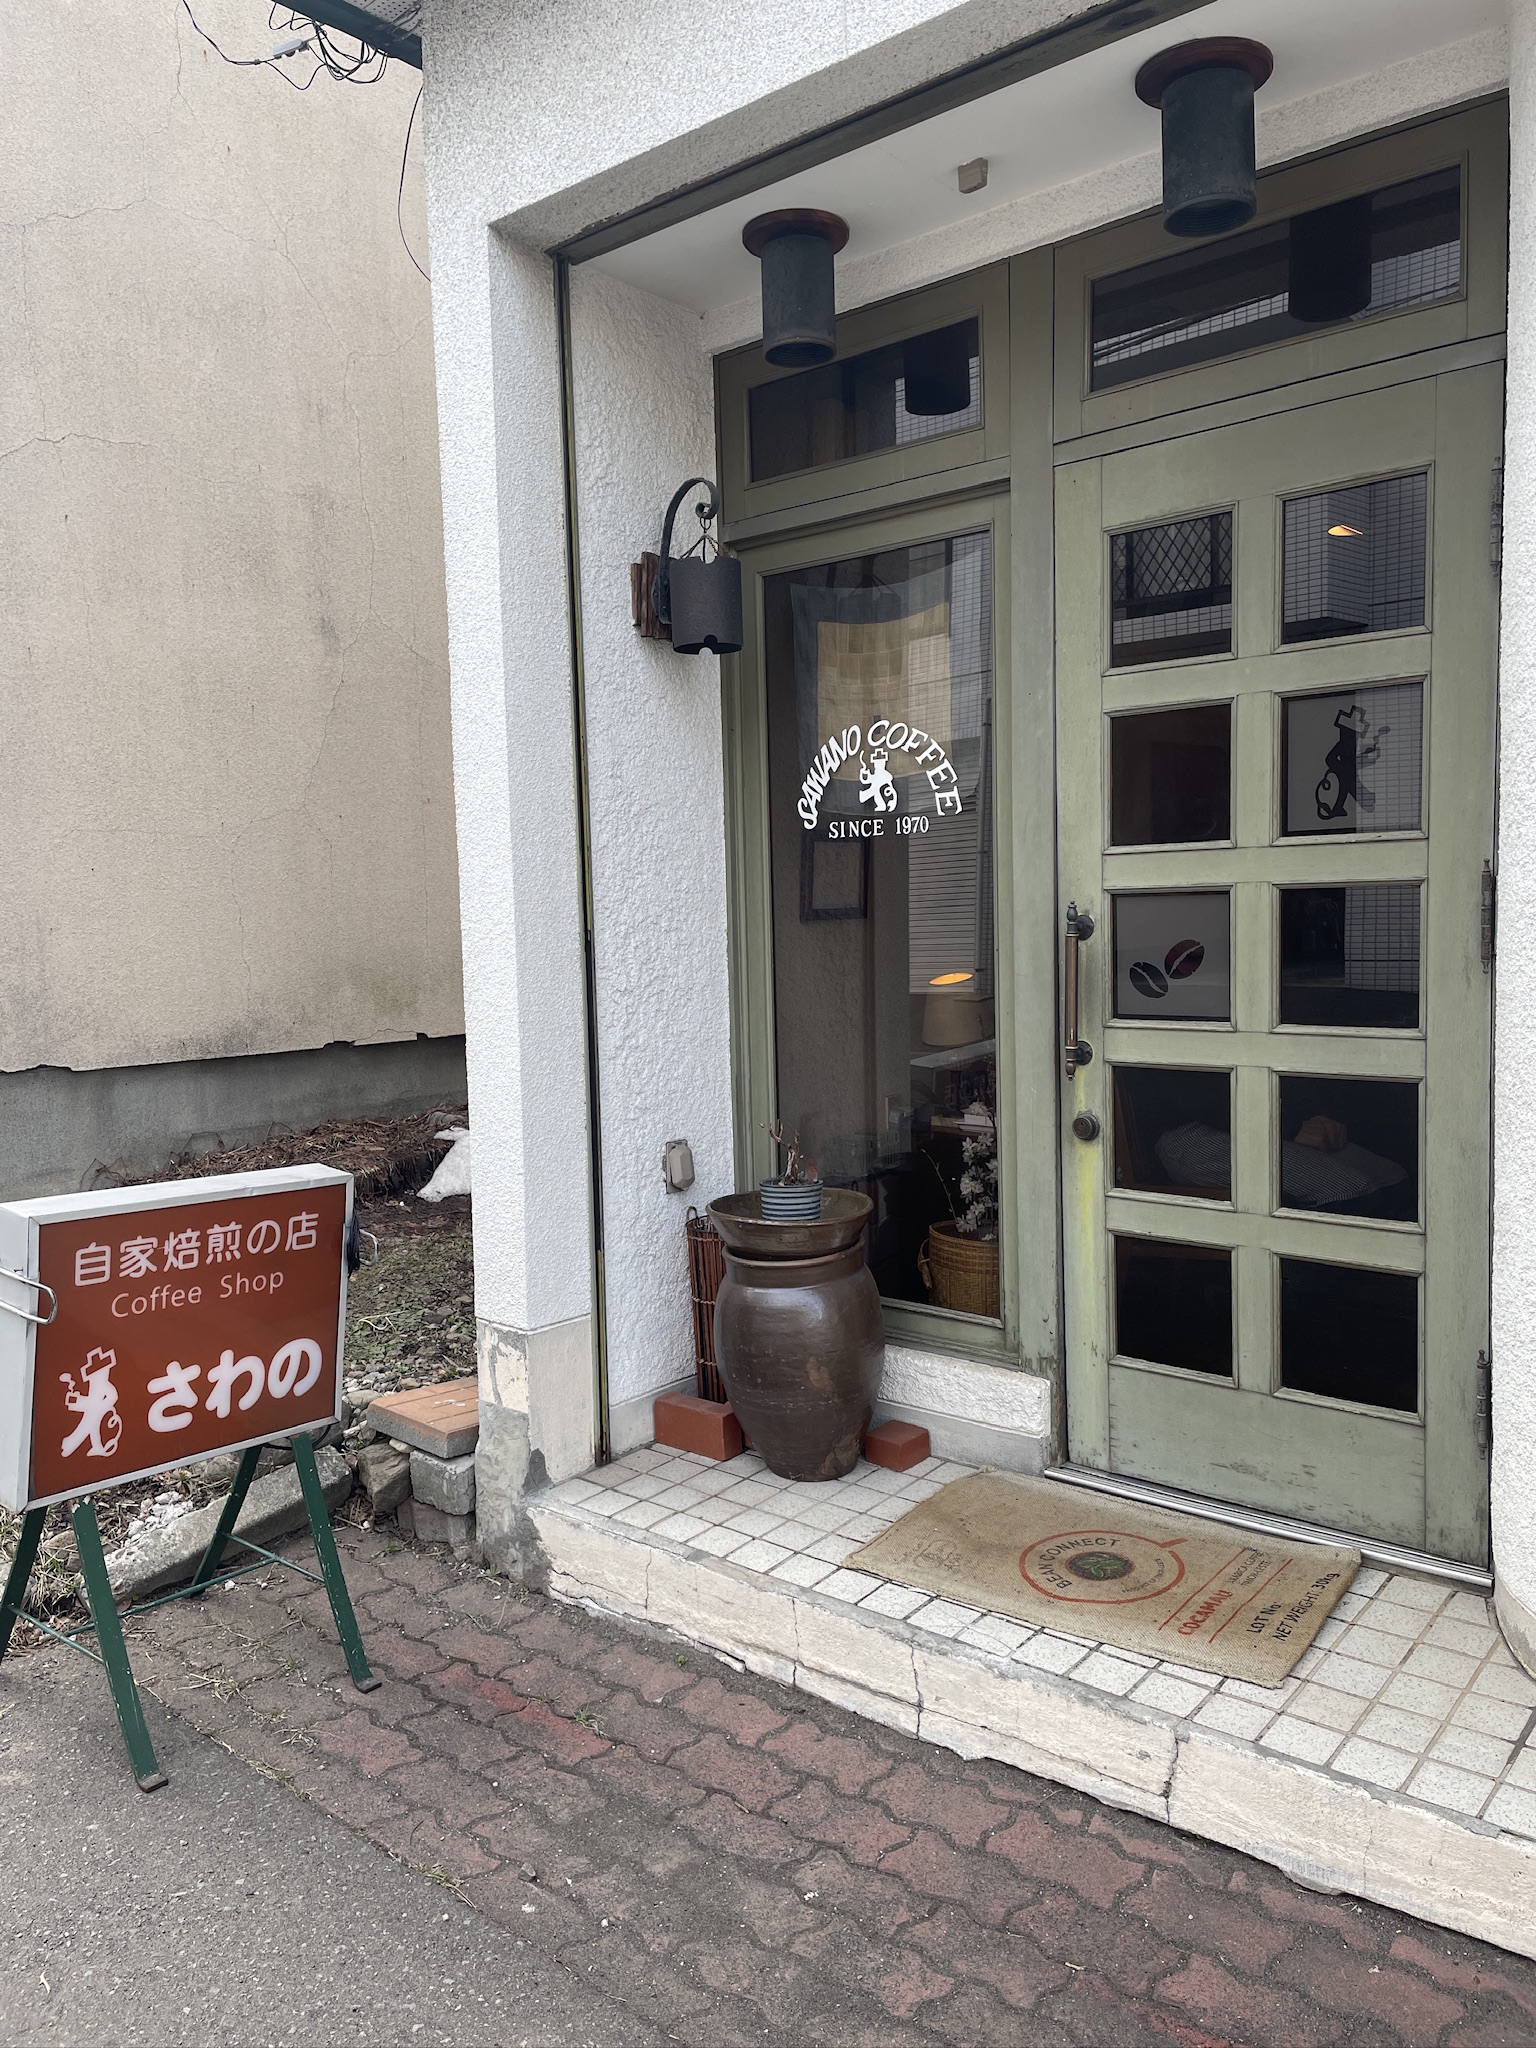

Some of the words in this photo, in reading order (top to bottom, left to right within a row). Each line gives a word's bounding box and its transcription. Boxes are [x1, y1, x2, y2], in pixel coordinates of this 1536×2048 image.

[797, 724, 862, 830] SAWANO
[867, 719, 963, 816] COFFEE
[828, 818, 884, 839] SINCE
[895, 815, 930, 835] 1970
[74, 1211, 320, 1287] 自家焙煎の店
[111, 1283, 202, 1319] Coffee
[219, 1270, 285, 1299] Shop
[147, 1337, 323, 1433] さわの
[1039, 1537, 1121, 1561] CONNECT
[1038, 1562, 1073, 1589] BEAN
[1177, 1589, 1233, 1636] COCAMAU
[1246, 1615, 1269, 1634] LOT
[1272, 1621, 1294, 1642] NET
[1311, 1572, 1341, 1590] 30kg
